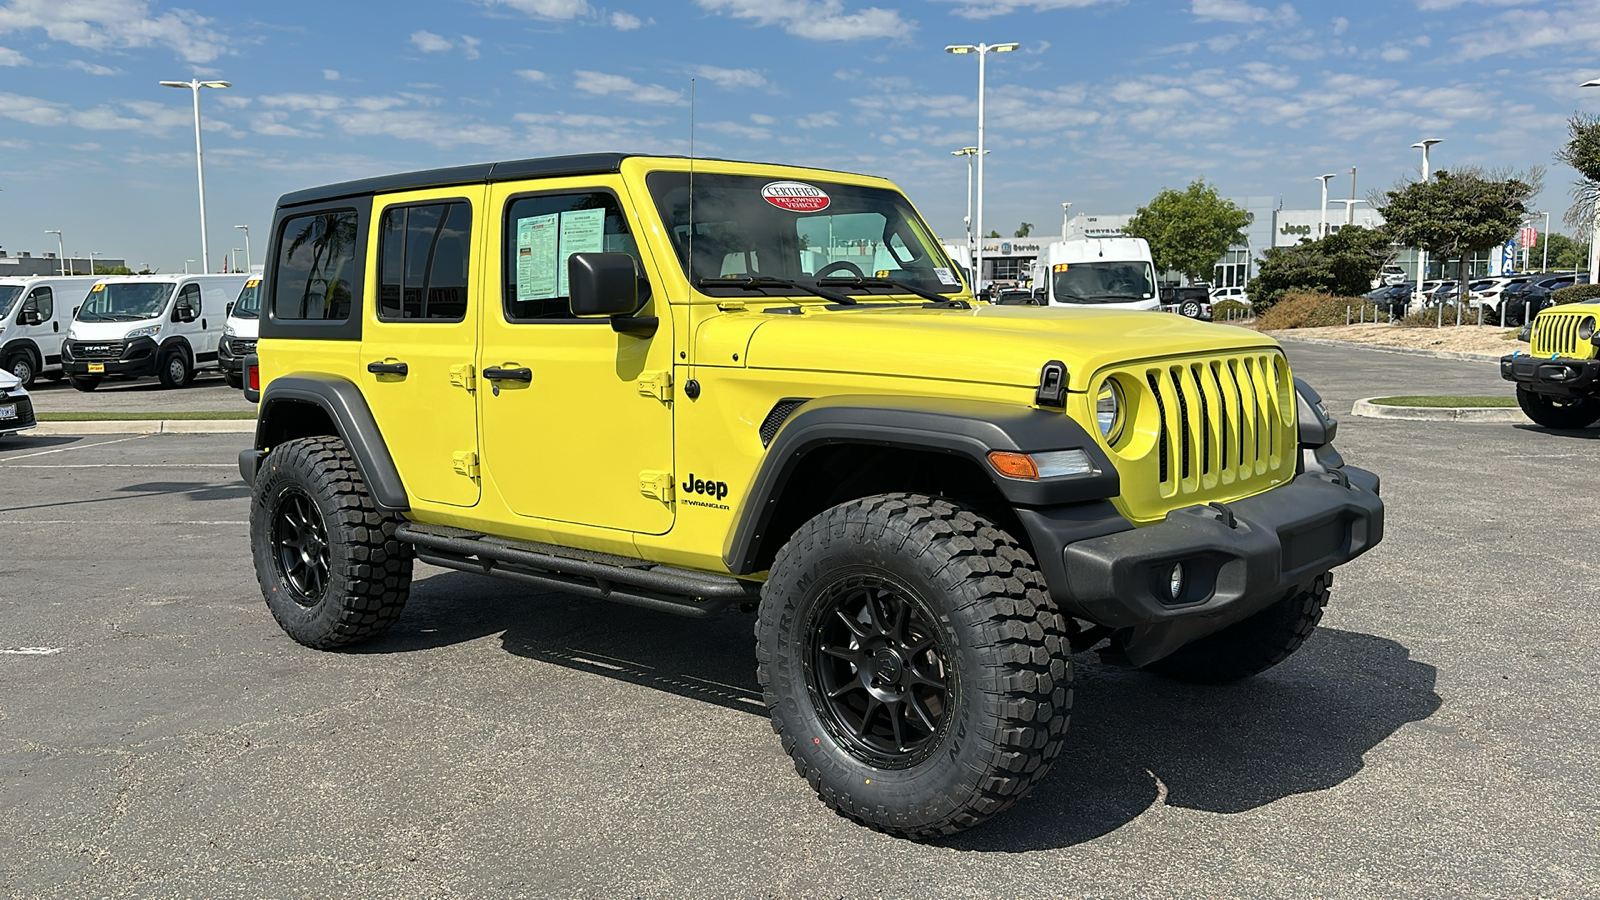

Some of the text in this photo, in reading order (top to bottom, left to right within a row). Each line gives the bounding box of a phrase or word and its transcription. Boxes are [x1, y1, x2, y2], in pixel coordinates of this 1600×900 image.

[766, 187, 820, 197] CERTIFIED
[1280, 222, 1311, 236] Jeep
[1013, 243, 1040, 252] Service
[682, 473, 728, 501] Jeep
[688, 500, 730, 510] WRANGLER
[776, 595, 808, 734] COUNTRY
